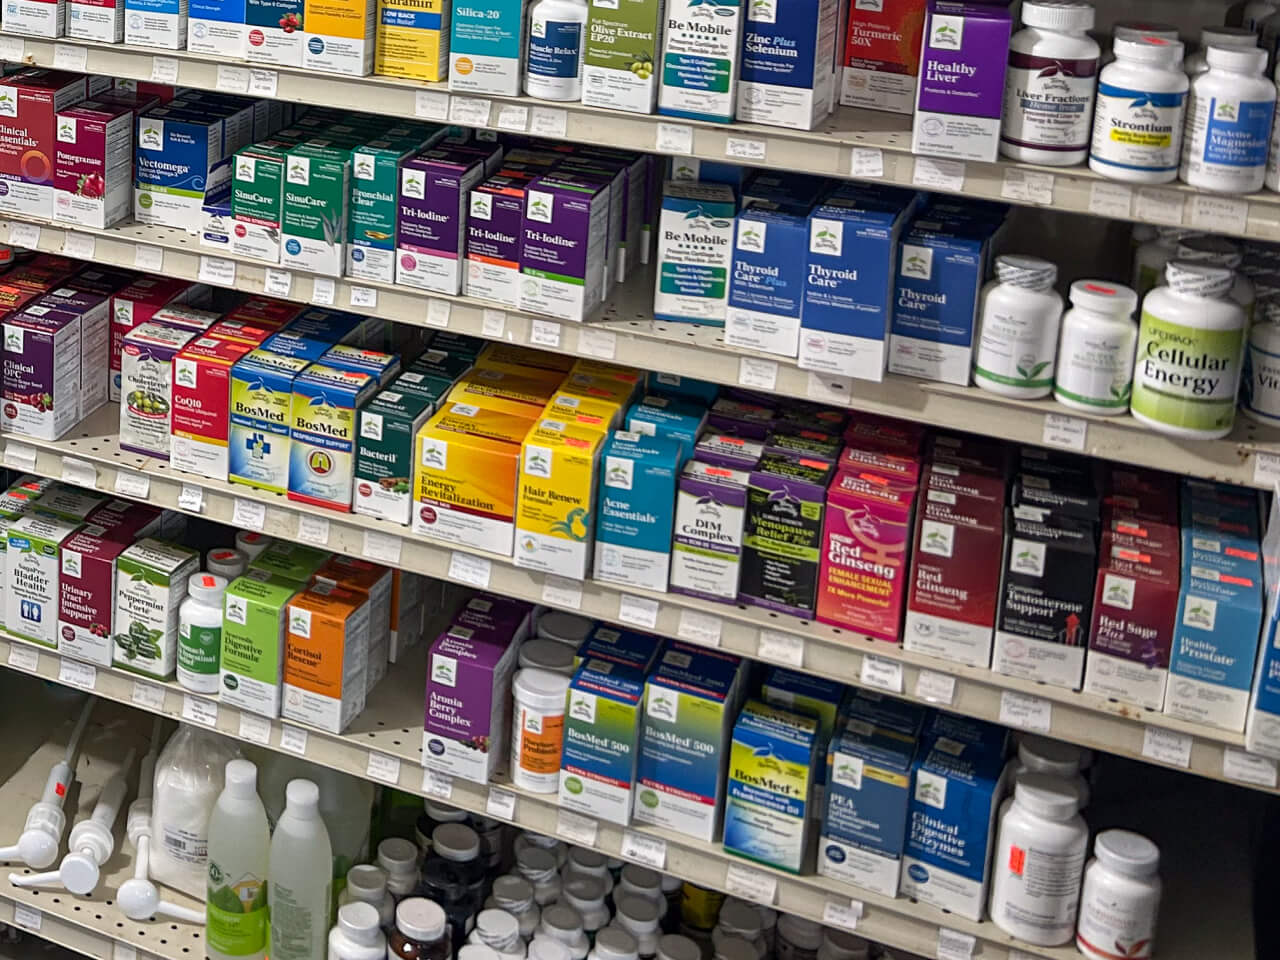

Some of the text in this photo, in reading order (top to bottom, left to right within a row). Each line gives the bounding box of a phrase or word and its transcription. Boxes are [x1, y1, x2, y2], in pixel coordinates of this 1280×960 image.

[591, 24, 652, 41] Olive Extract
[669, 20, 731, 36] Be Mobile
[852, 27, 902, 42] Turmeric
[746, 33, 796, 48] Zinc Plus
[745, 44, 798, 58] Selenium
[927, 71, 958, 84] Liver
[928, 61, 976, 77] Healthy
[1111, 118, 1172, 134] Strontium
[139, 156, 188, 174] Vectomega
[235, 189, 272, 205] SinuCare
[808, 274, 836, 287] Care
[809, 263, 857, 282] Thyroid
[1146, 340, 1230, 373] Cellular
[4, 359, 34, 374] Clinical
[1144, 359, 1221, 396] Energy
[236, 401, 284, 423] BosMed
[296, 417, 347, 438] BosMed
[421, 476, 455, 493] Energy
[421, 485, 493, 511] Revitalization
[524, 485, 581, 505] Hair Renew
[830, 540, 860, 558] Red
[829, 551, 894, 579] Ginseng
[1181, 644, 1234, 666] Prostate
[430, 691, 462, 708] Aronia
[430, 698, 456, 715] Berry
[430, 707, 471, 727] Complex
